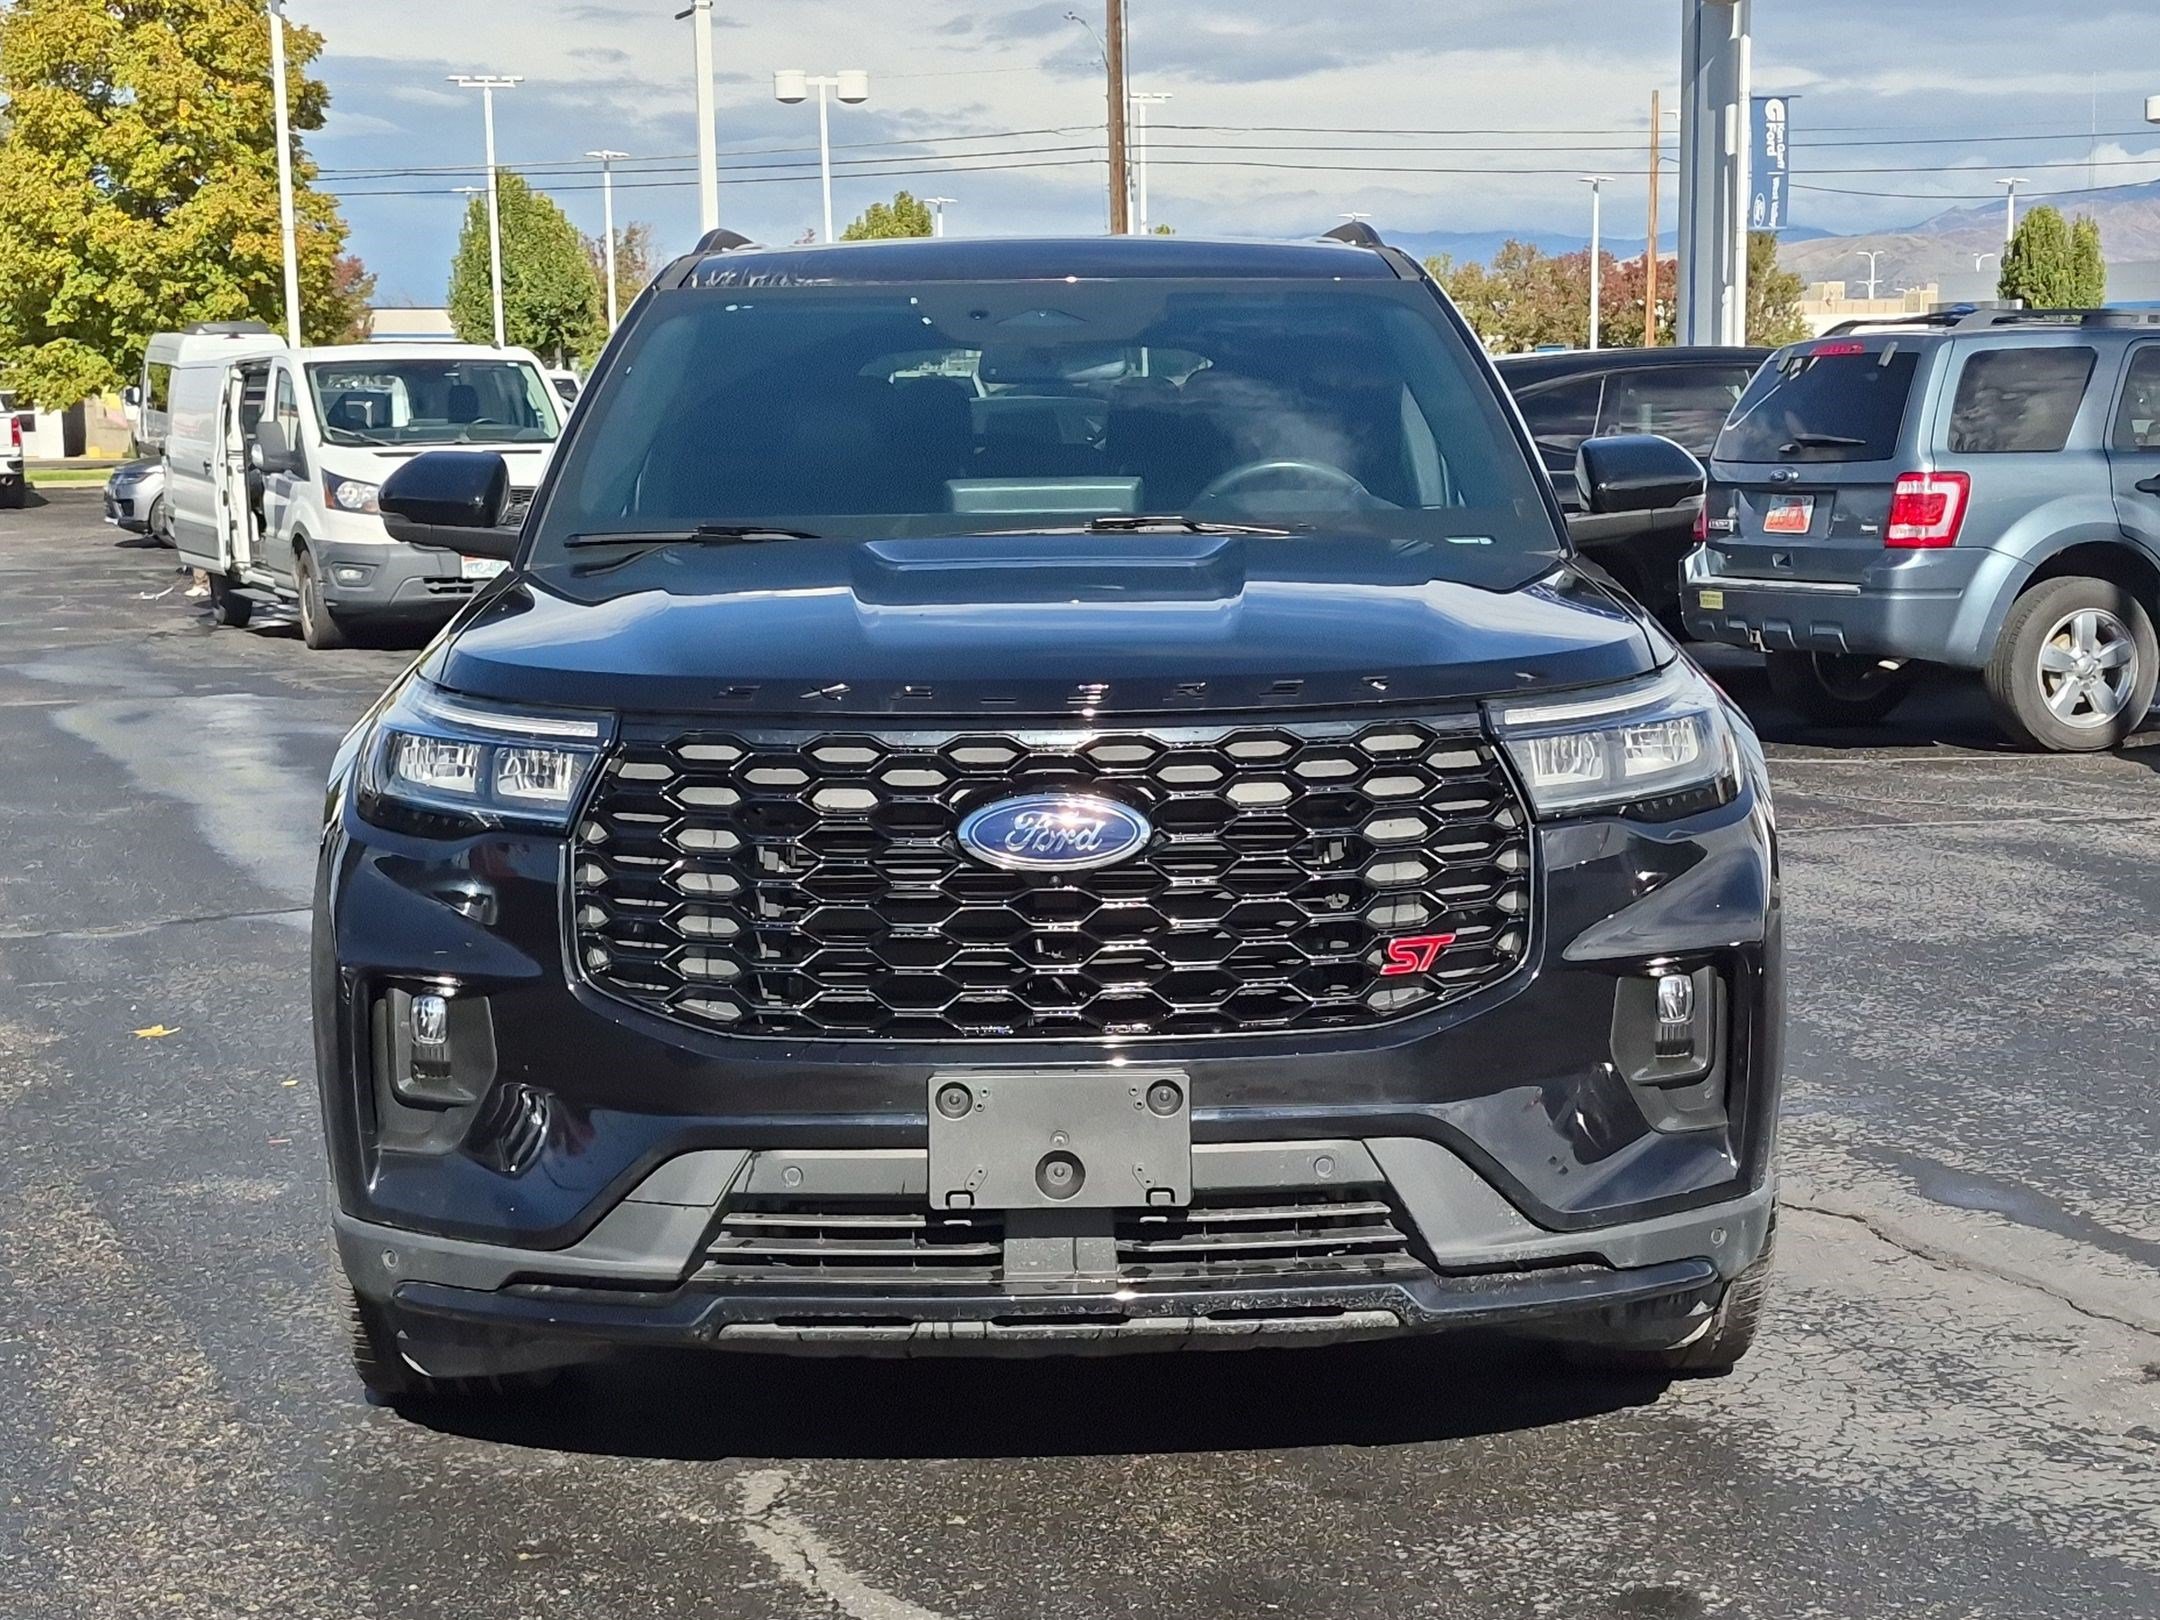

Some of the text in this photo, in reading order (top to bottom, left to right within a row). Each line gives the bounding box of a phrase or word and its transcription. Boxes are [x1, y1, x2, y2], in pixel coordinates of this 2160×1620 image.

[1766, 122, 1778, 157] Ford
[1005, 810, 1106, 852] Ford
[1380, 932, 1457, 976] ST
